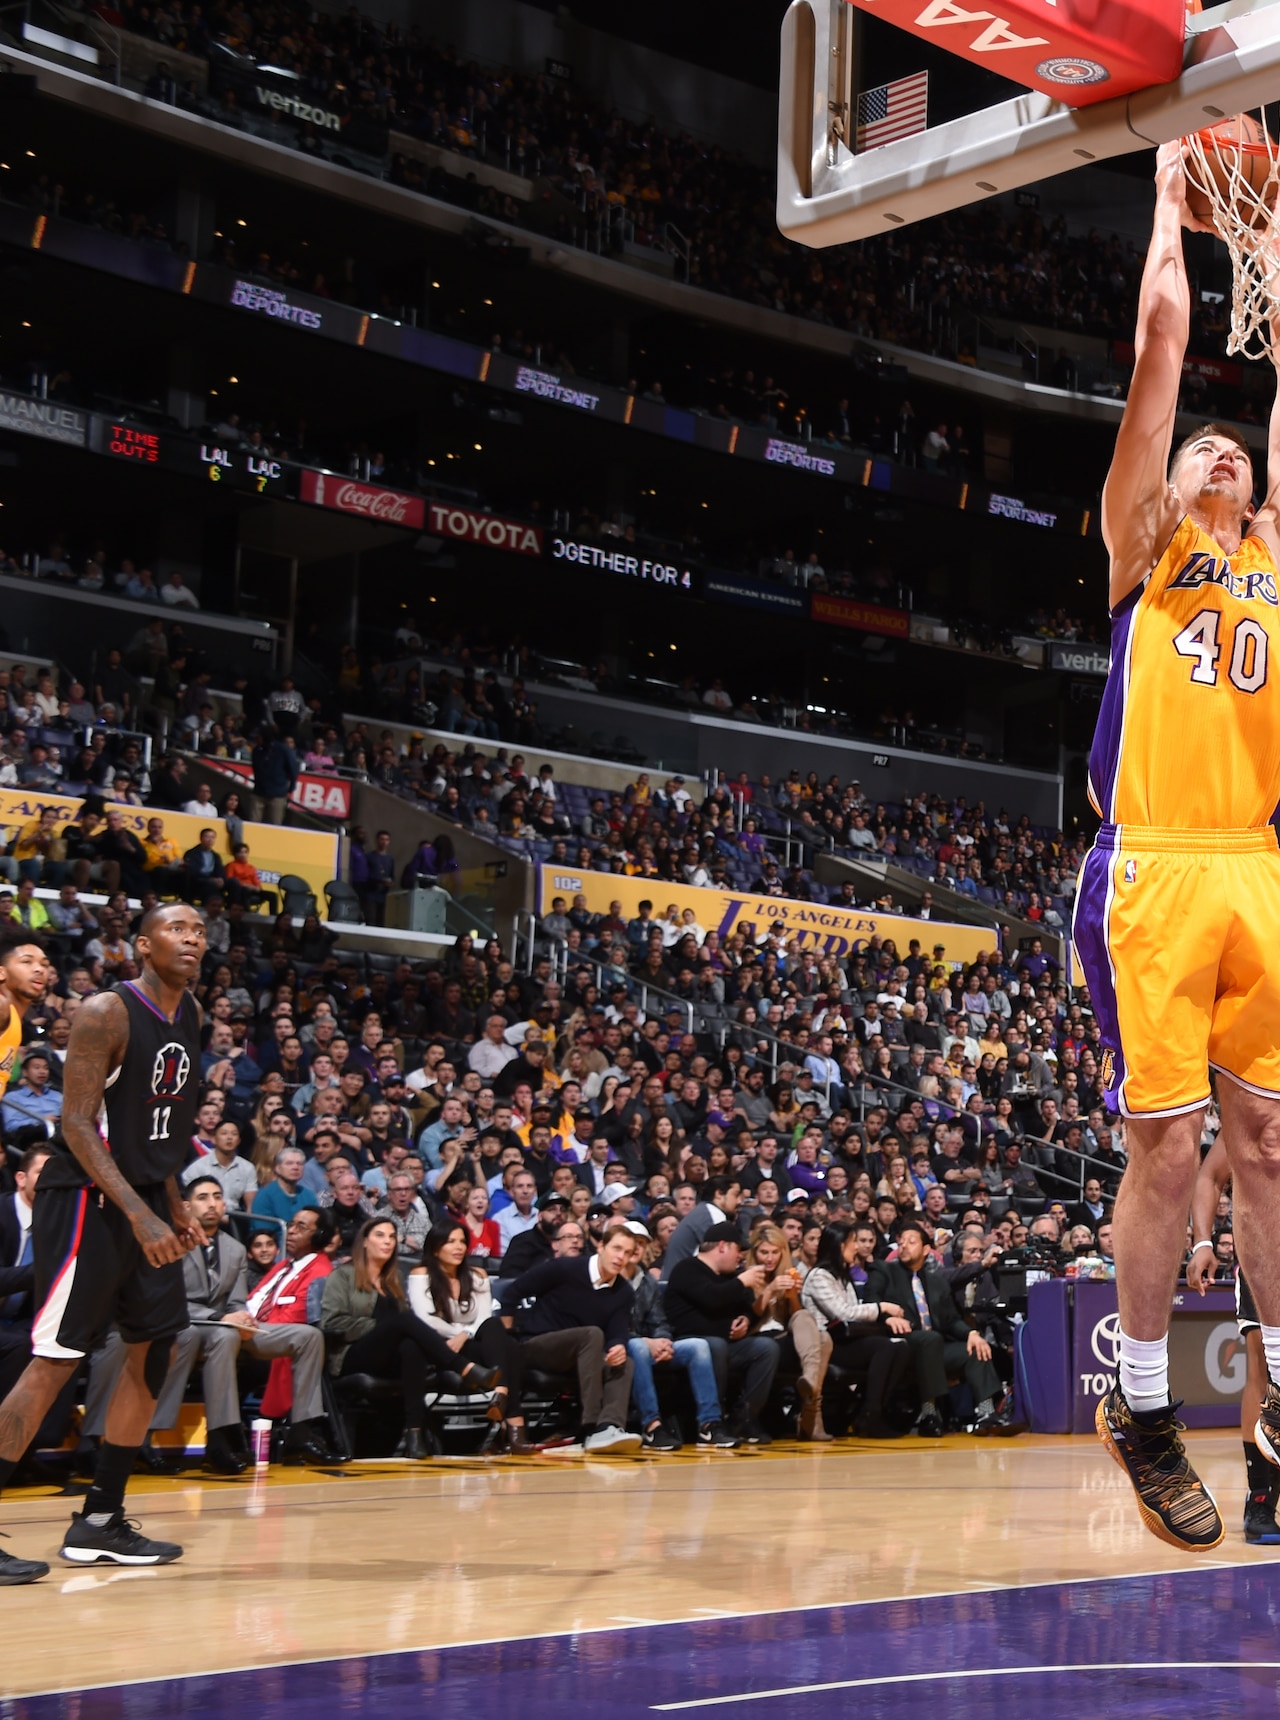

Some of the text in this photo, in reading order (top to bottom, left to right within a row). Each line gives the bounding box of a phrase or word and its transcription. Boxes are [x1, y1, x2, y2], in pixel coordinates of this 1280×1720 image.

[255, 86, 341, 132] verizon
[231, 290, 322, 329] DEPORTES
[515, 375, 600, 411] SPORTSNET
[112, 425, 160, 449] TIME
[109, 441, 160, 463] OUTS
[201, 444, 233, 467] LAL
[764, 446, 836, 475] DEPORTES
[209, 464, 222, 482] 6
[247, 456, 281, 479] LAC
[256, 475, 269, 492] 7
[336, 483, 410, 523] Coca-Cola
[988, 501, 1057, 528] SPORTSNET
[431, 506, 541, 555] TOYOTA
[642, 560, 679, 586] FOR
[680, 570, 692, 589] 4
[1165, 552, 1280, 606] LAKERS
[708, 582, 803, 607] AMERICAN EXPRESS
[815, 601, 907, 631] WELLS FARGO
[1173, 608, 1269, 695] 40
[554, 876, 583, 892] 102
[756, 902, 878, 933] LOS ANGELES
[149, 1106, 172, 1141] 11
[1080, 1373, 1117, 1396] TOY
